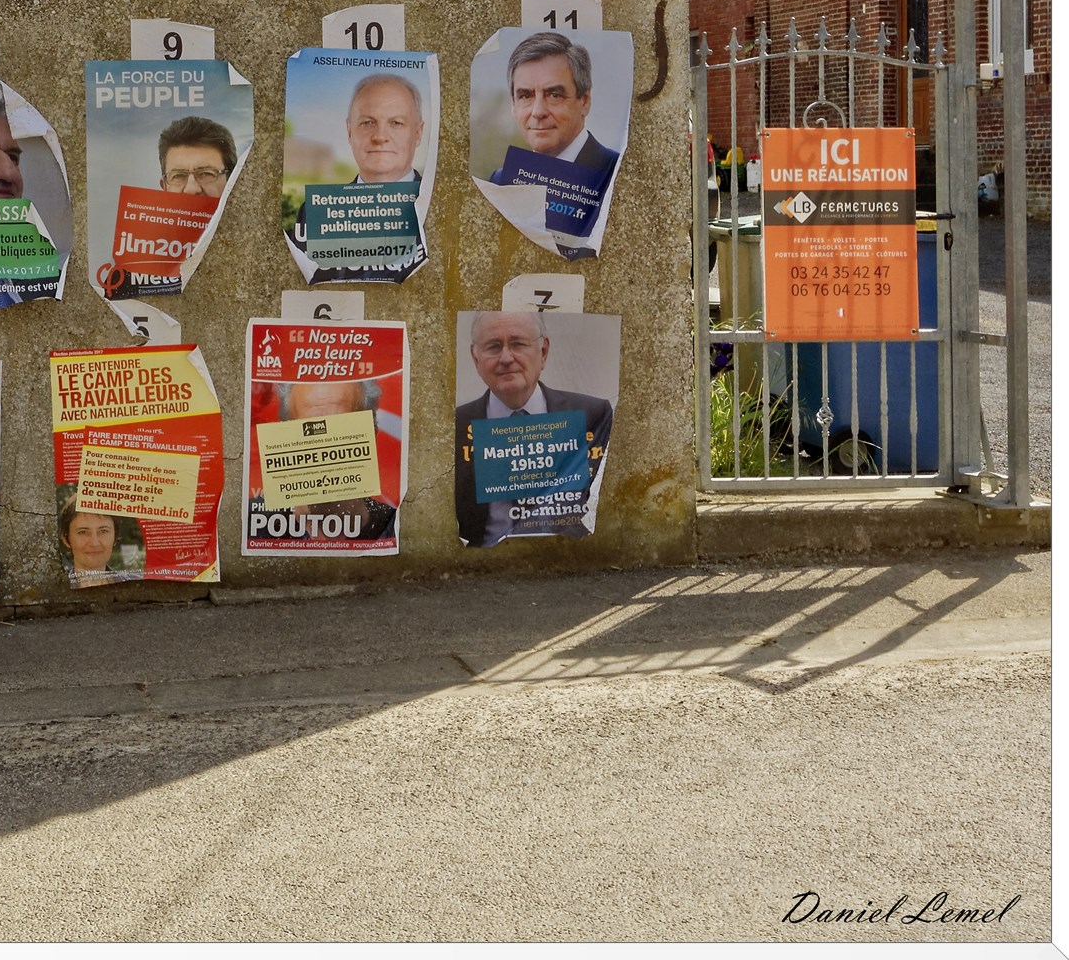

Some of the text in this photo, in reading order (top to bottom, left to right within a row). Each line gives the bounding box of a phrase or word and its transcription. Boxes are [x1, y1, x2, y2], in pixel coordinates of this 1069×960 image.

[543, 10, 578, 30] 11
[345, 22, 384, 50] 10
[163, 31, 183, 60] 9
[313, 57, 426, 69] ASSELINEAU PRÉSIDENT
[95, 70, 204, 85] LA FORCE DU
[96, 86, 205, 109] PEUPLE
[821, 138, 860, 165] ICI
[518, 168, 571, 189] Pour dates
[771, 166, 908, 182] UNE RÉALISATION
[312, 193, 416, 206] Retrouvez toutes
[562, 191, 600, 207] publiques
[327, 206, 402, 219] les réunions
[794, 201, 900, 214] LB FERMETURES
[124, 211, 174, 225] La France
[321, 220, 381, 235] publiques
[0, 234, 34, 244] toutes
[791, 266, 890, 279] 03 24 35 42 47
[28, 283, 41, 292] est
[791, 283, 891, 296] 06 76 04 25 39
[534, 290, 553, 312] 7
[313, 303, 333, 320] 6
[309, 329, 373, 346] Nos vies,
[257, 356, 282, 368] NPA
[294, 346, 363, 363] pas leurs
[57, 359, 141, 374] FAIRE ENTENDRE
[58, 367, 172, 391] LE CAMP DES
[58, 383, 192, 409] TRAVAILLEURS
[61, 402, 190, 421] AVEC NATHALIE ARTHAUD
[491, 421, 568, 435] Meeting participatif
[88, 431, 154, 443] FAIRE ENTENDRE
[521, 432, 553, 441] internet
[100, 439, 123, 447] CAMP
[142, 442, 198, 453] TRAVAILLEURS
[483, 439, 579, 460] Mardi 18 avril
[86, 451, 103, 459] Pour
[266, 446, 371, 469] PHILIPPE POUTOU
[97, 460, 151, 472] lieux heures
[510, 456, 554, 472] 19h30
[84, 468, 126, 480] réunions
[83, 480, 163, 495] consultez site
[485, 473, 581, 494] www.cheminade2017.fr
[82, 488, 94, 496] de
[80, 499, 189, 519] nathalie-arthaud.info
[250, 513, 362, 538] POUTOU
[306, 541, 350, 549] anticapitaliste
